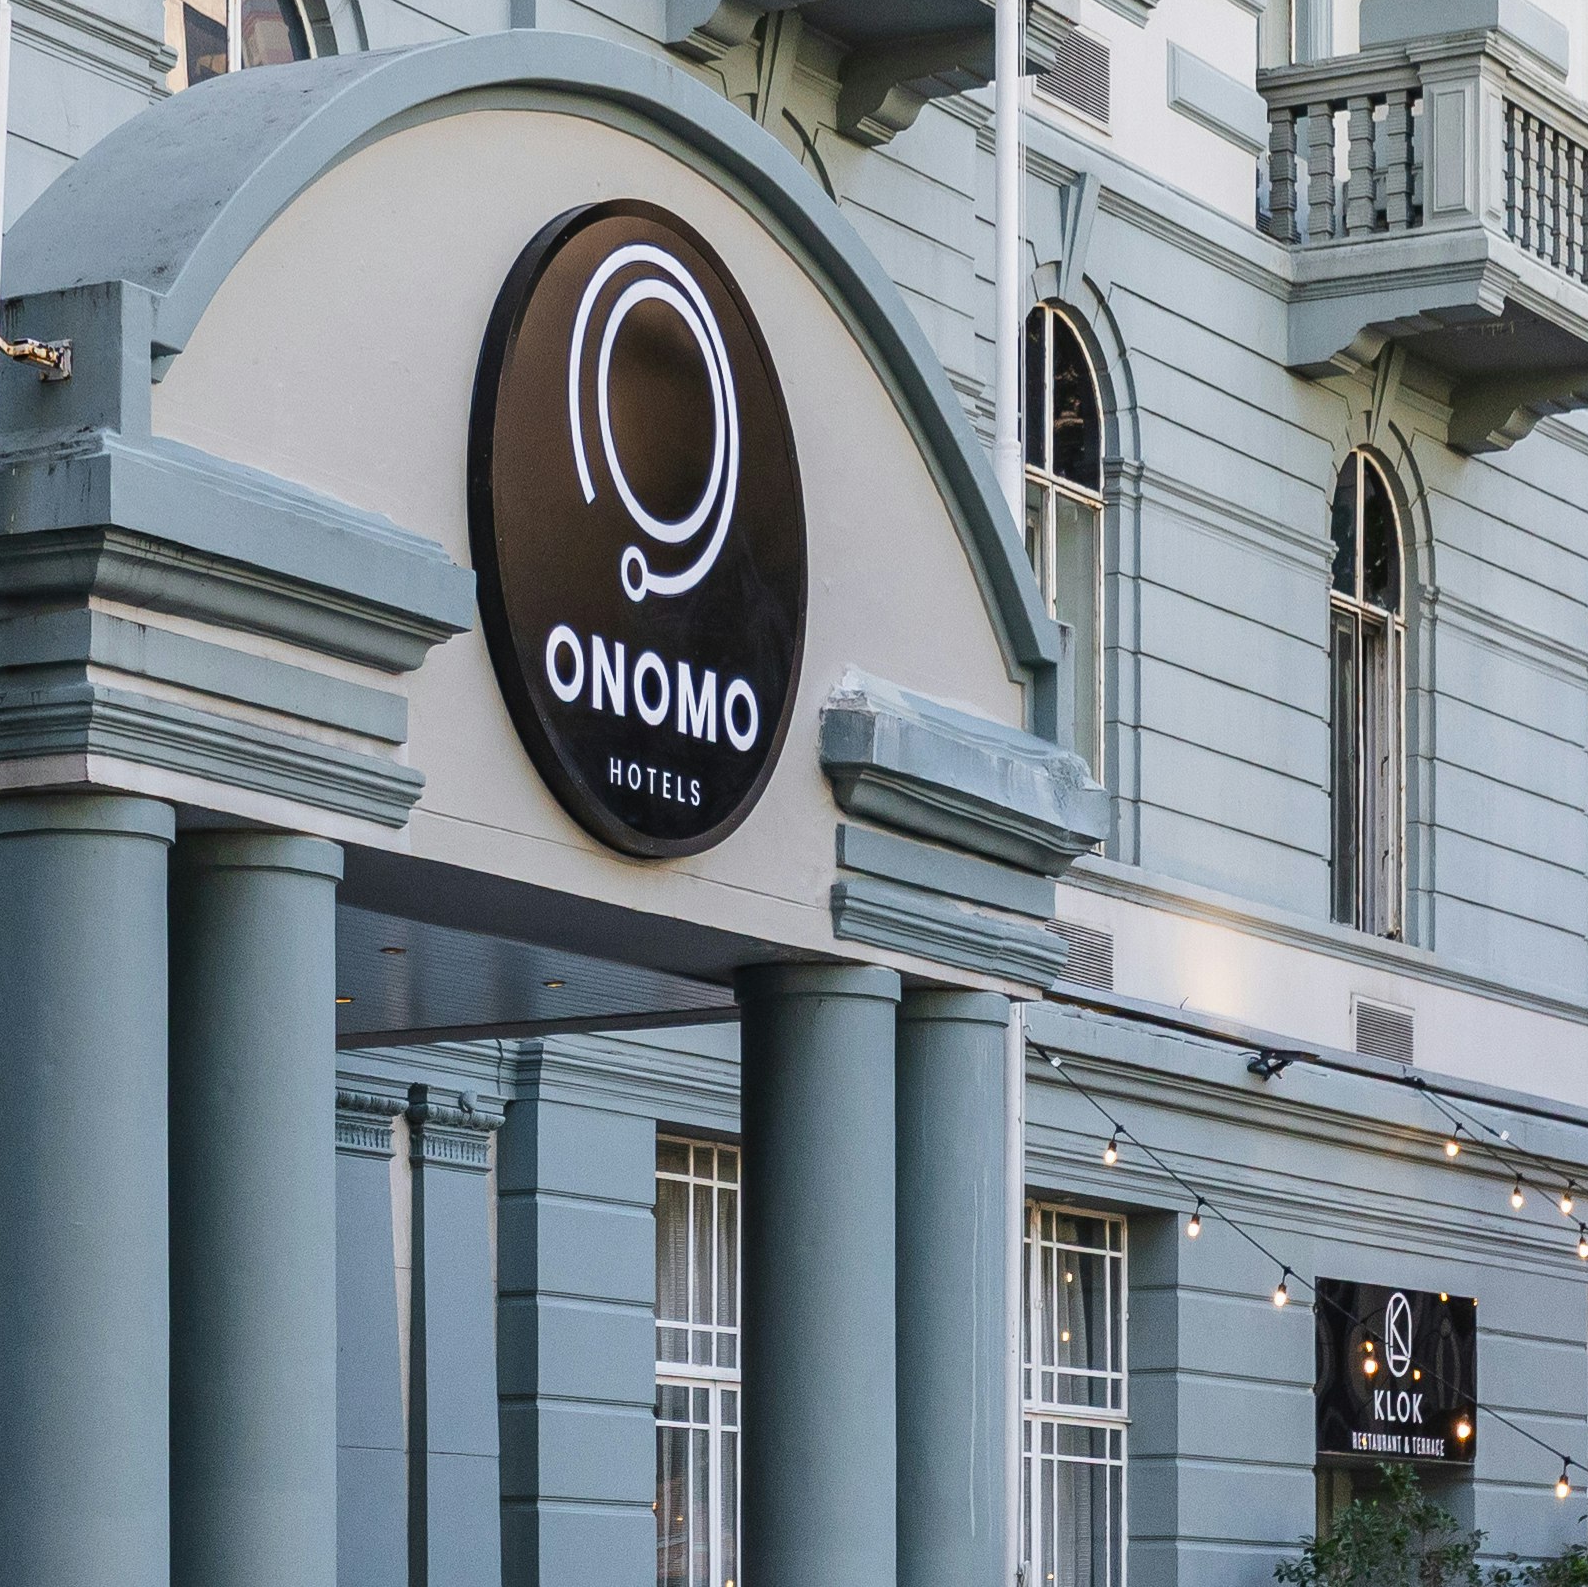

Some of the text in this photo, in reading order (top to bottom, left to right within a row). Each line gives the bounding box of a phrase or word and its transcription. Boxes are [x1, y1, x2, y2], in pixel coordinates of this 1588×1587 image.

[545, 624, 759, 751] ONOMO
[609, 757, 701, 807] HOTELS
[1374, 1389, 1423, 1424] KLOK
[1352, 1431, 1402, 1453] RESTAURANT
[1412, 1436, 1445, 1457] TERRACE
